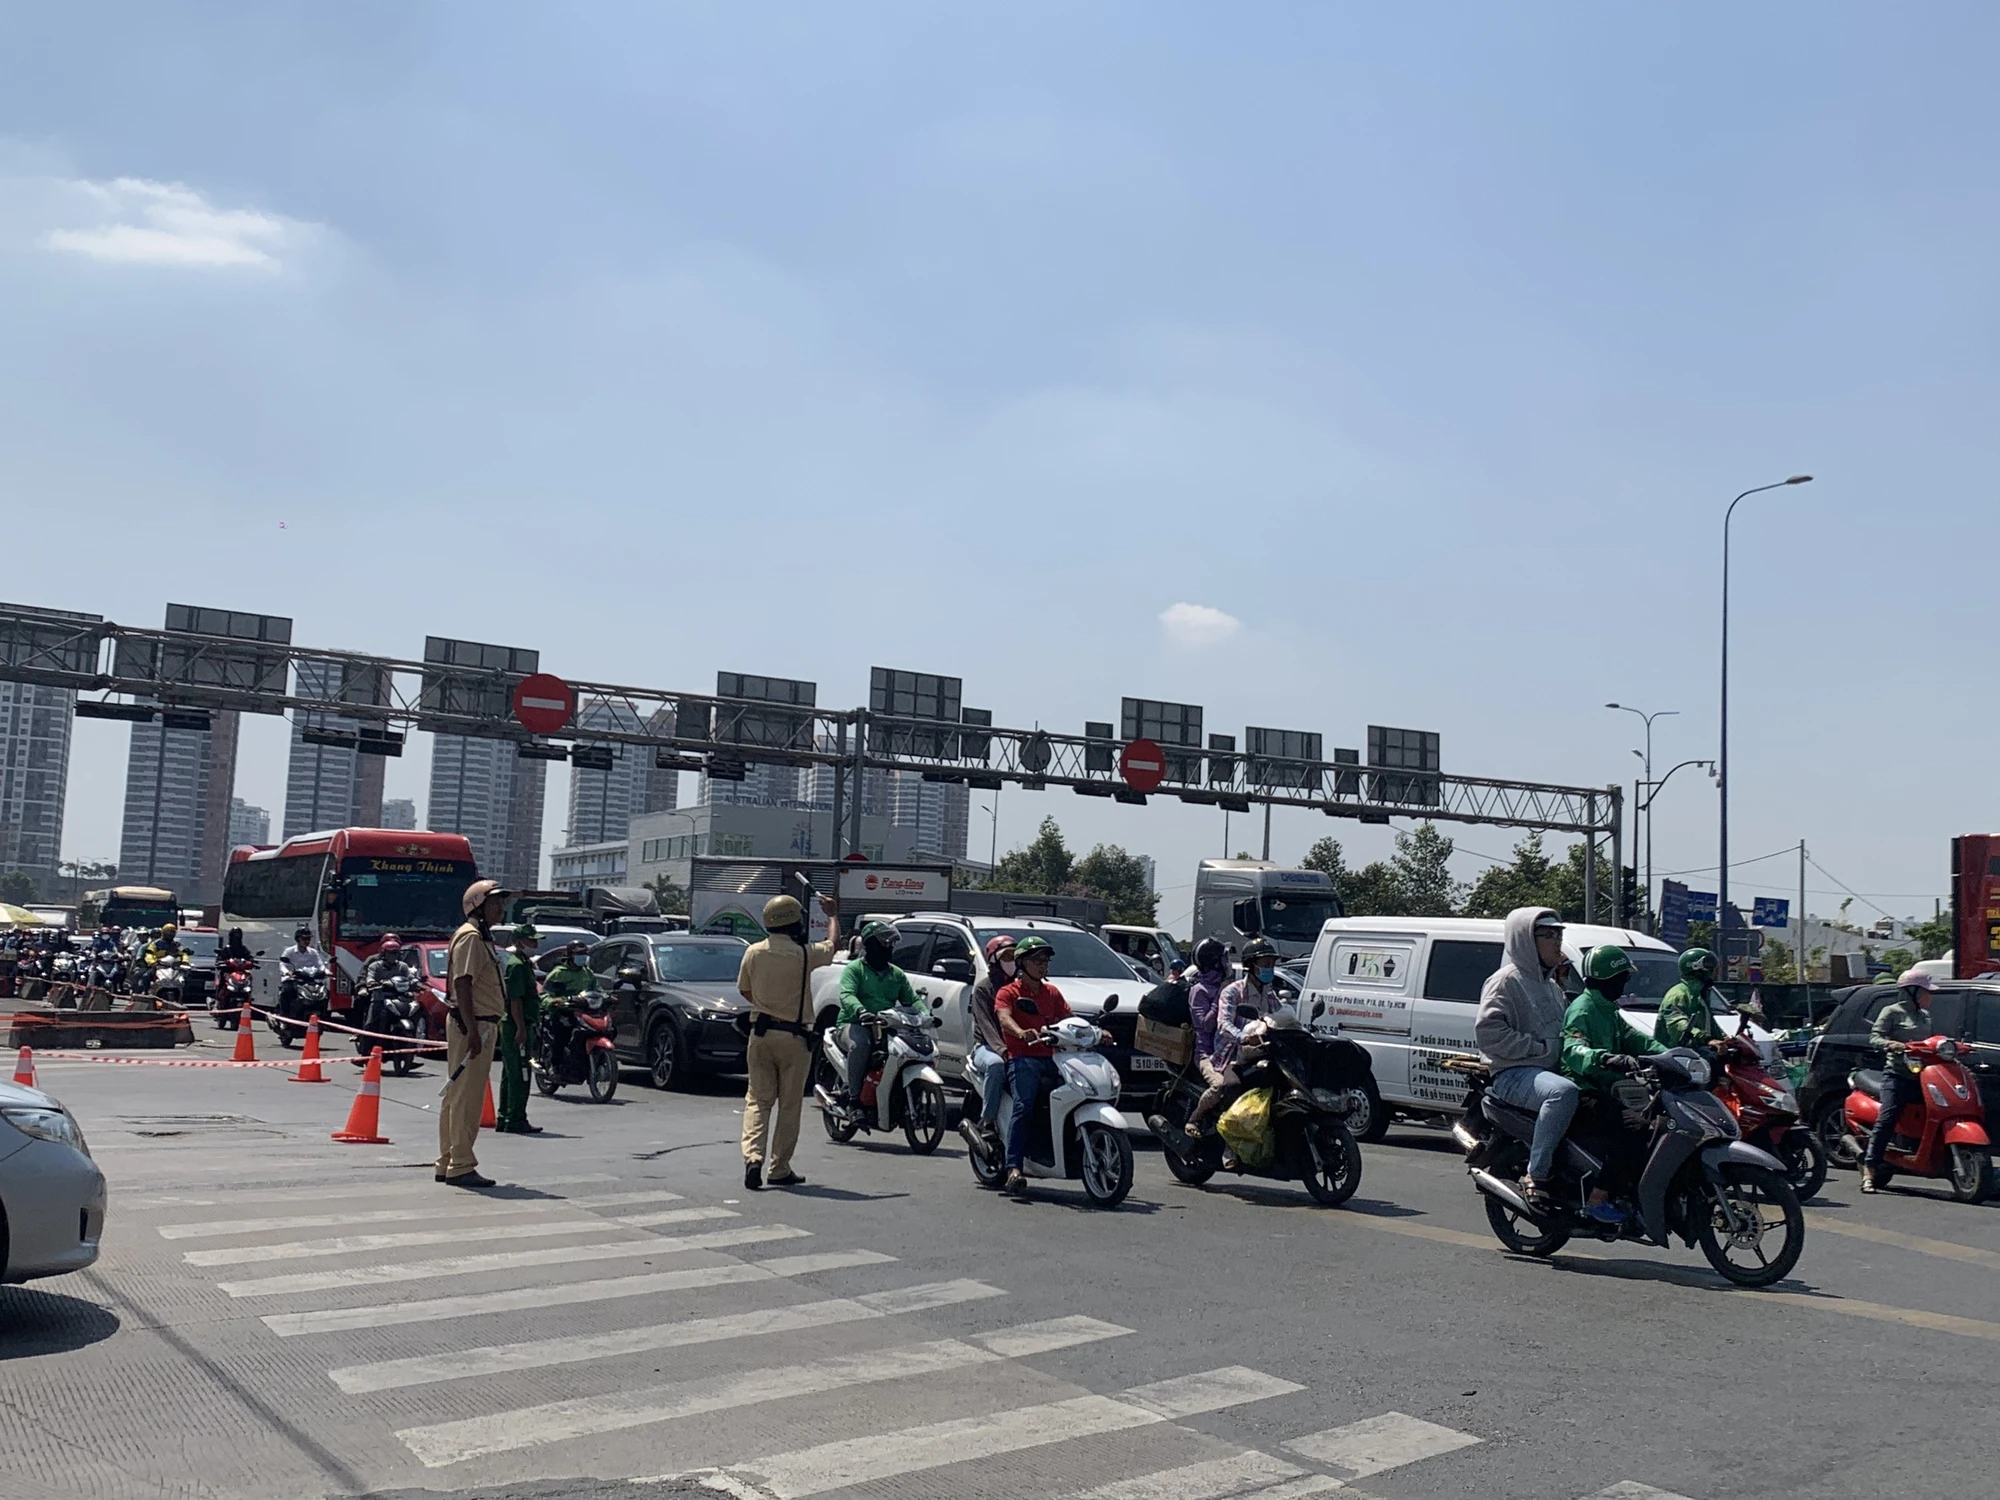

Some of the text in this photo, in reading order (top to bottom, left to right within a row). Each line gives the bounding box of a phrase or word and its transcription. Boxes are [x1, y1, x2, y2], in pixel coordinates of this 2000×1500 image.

[724, 795, 778, 808] AUSTRALIAN
[780, 799, 833, 811] INTERNATION
[370, 859, 412, 873] Khang
[1610, 957, 1627, 968] Grab
[1439, 1090, 1456, 1102] trang
